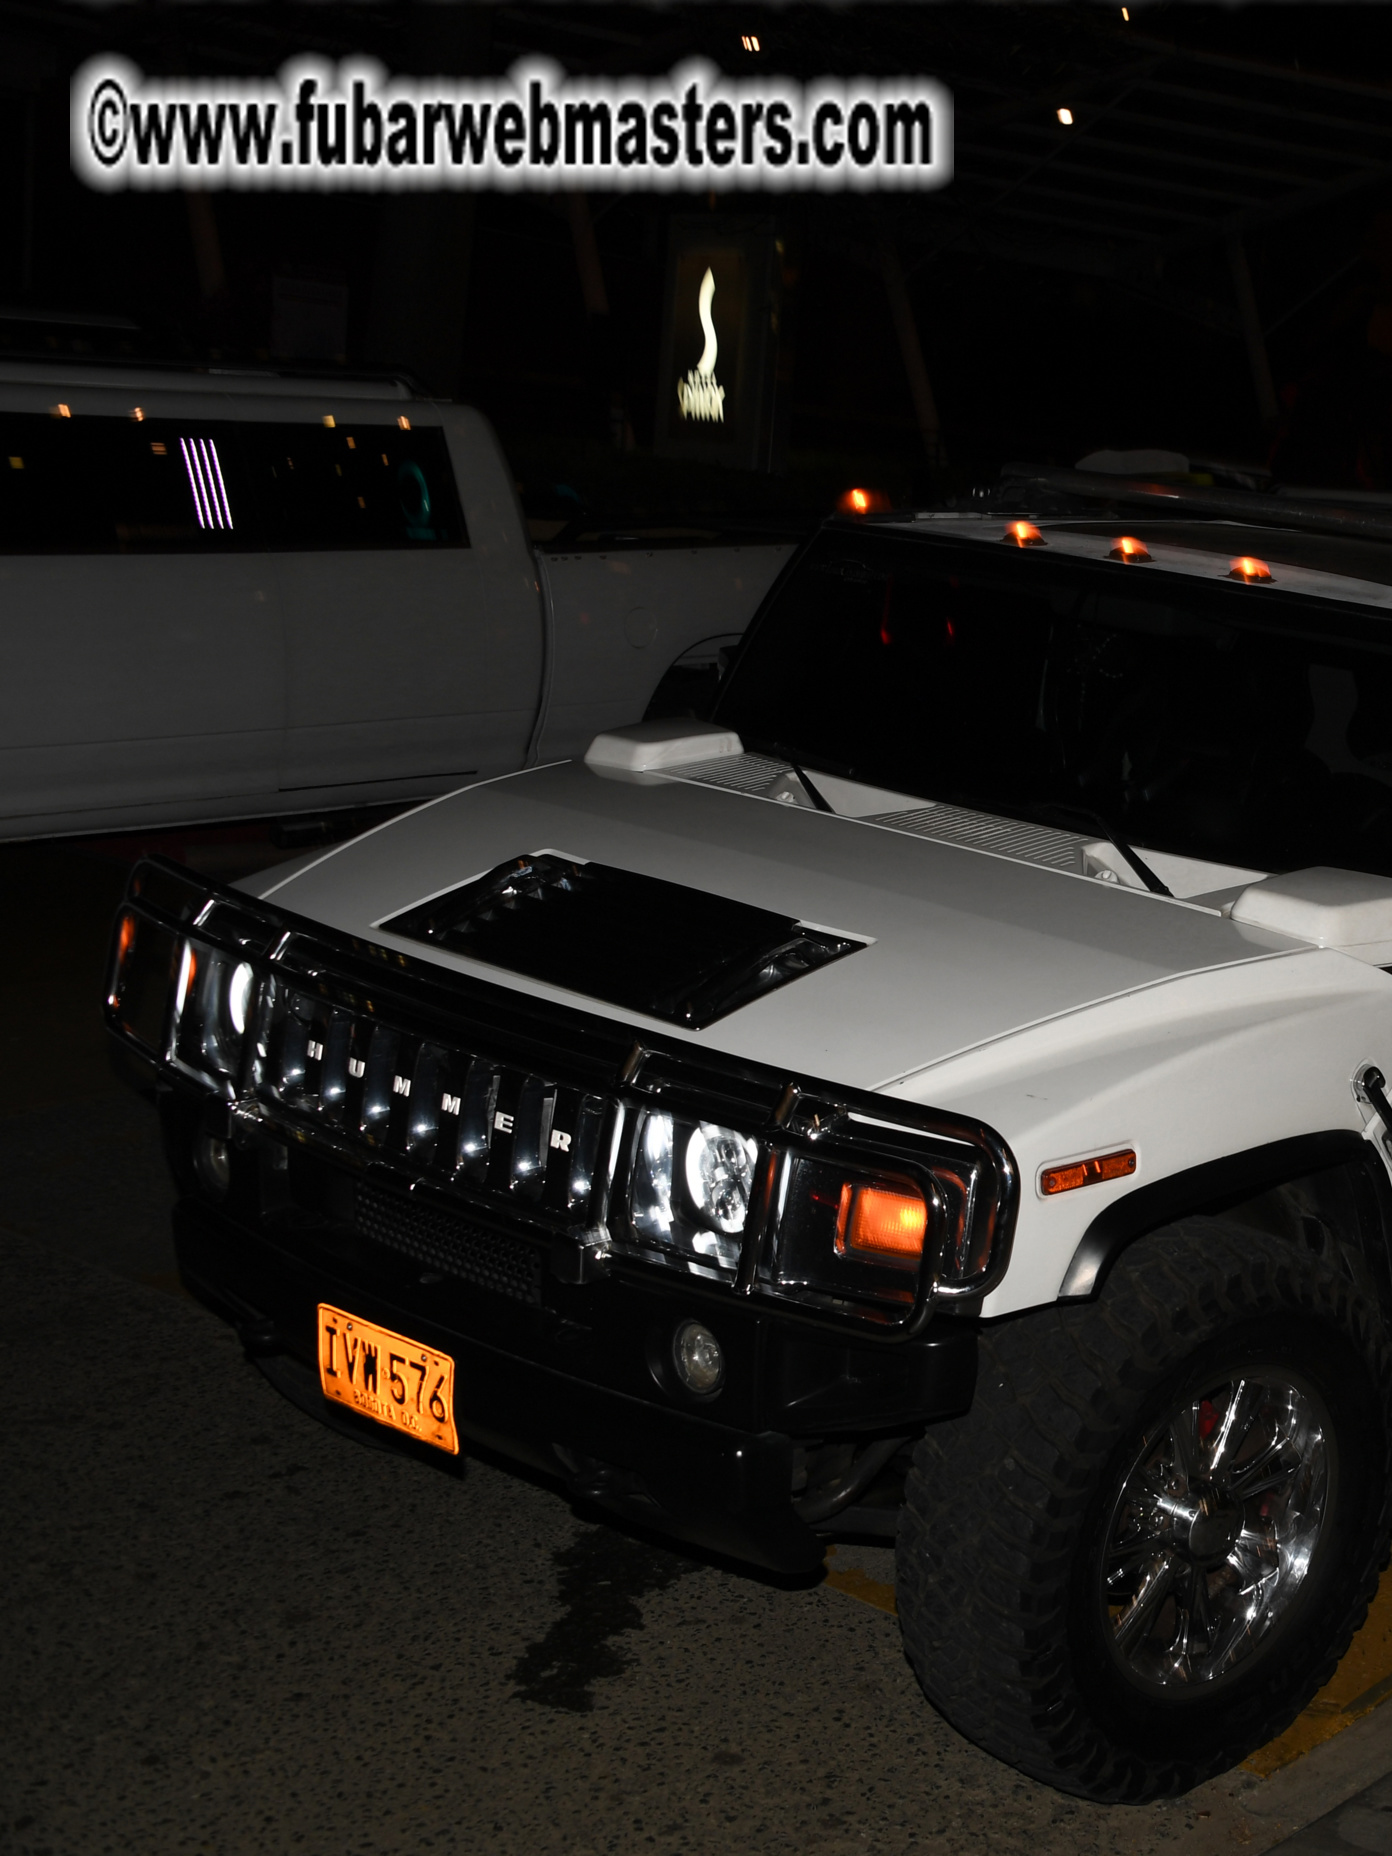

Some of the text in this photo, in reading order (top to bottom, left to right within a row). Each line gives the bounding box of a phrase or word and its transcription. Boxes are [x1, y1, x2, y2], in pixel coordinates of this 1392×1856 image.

[306, 1038, 574, 1153] HUMMER
[325, 1325, 449, 1424] IVW 576
